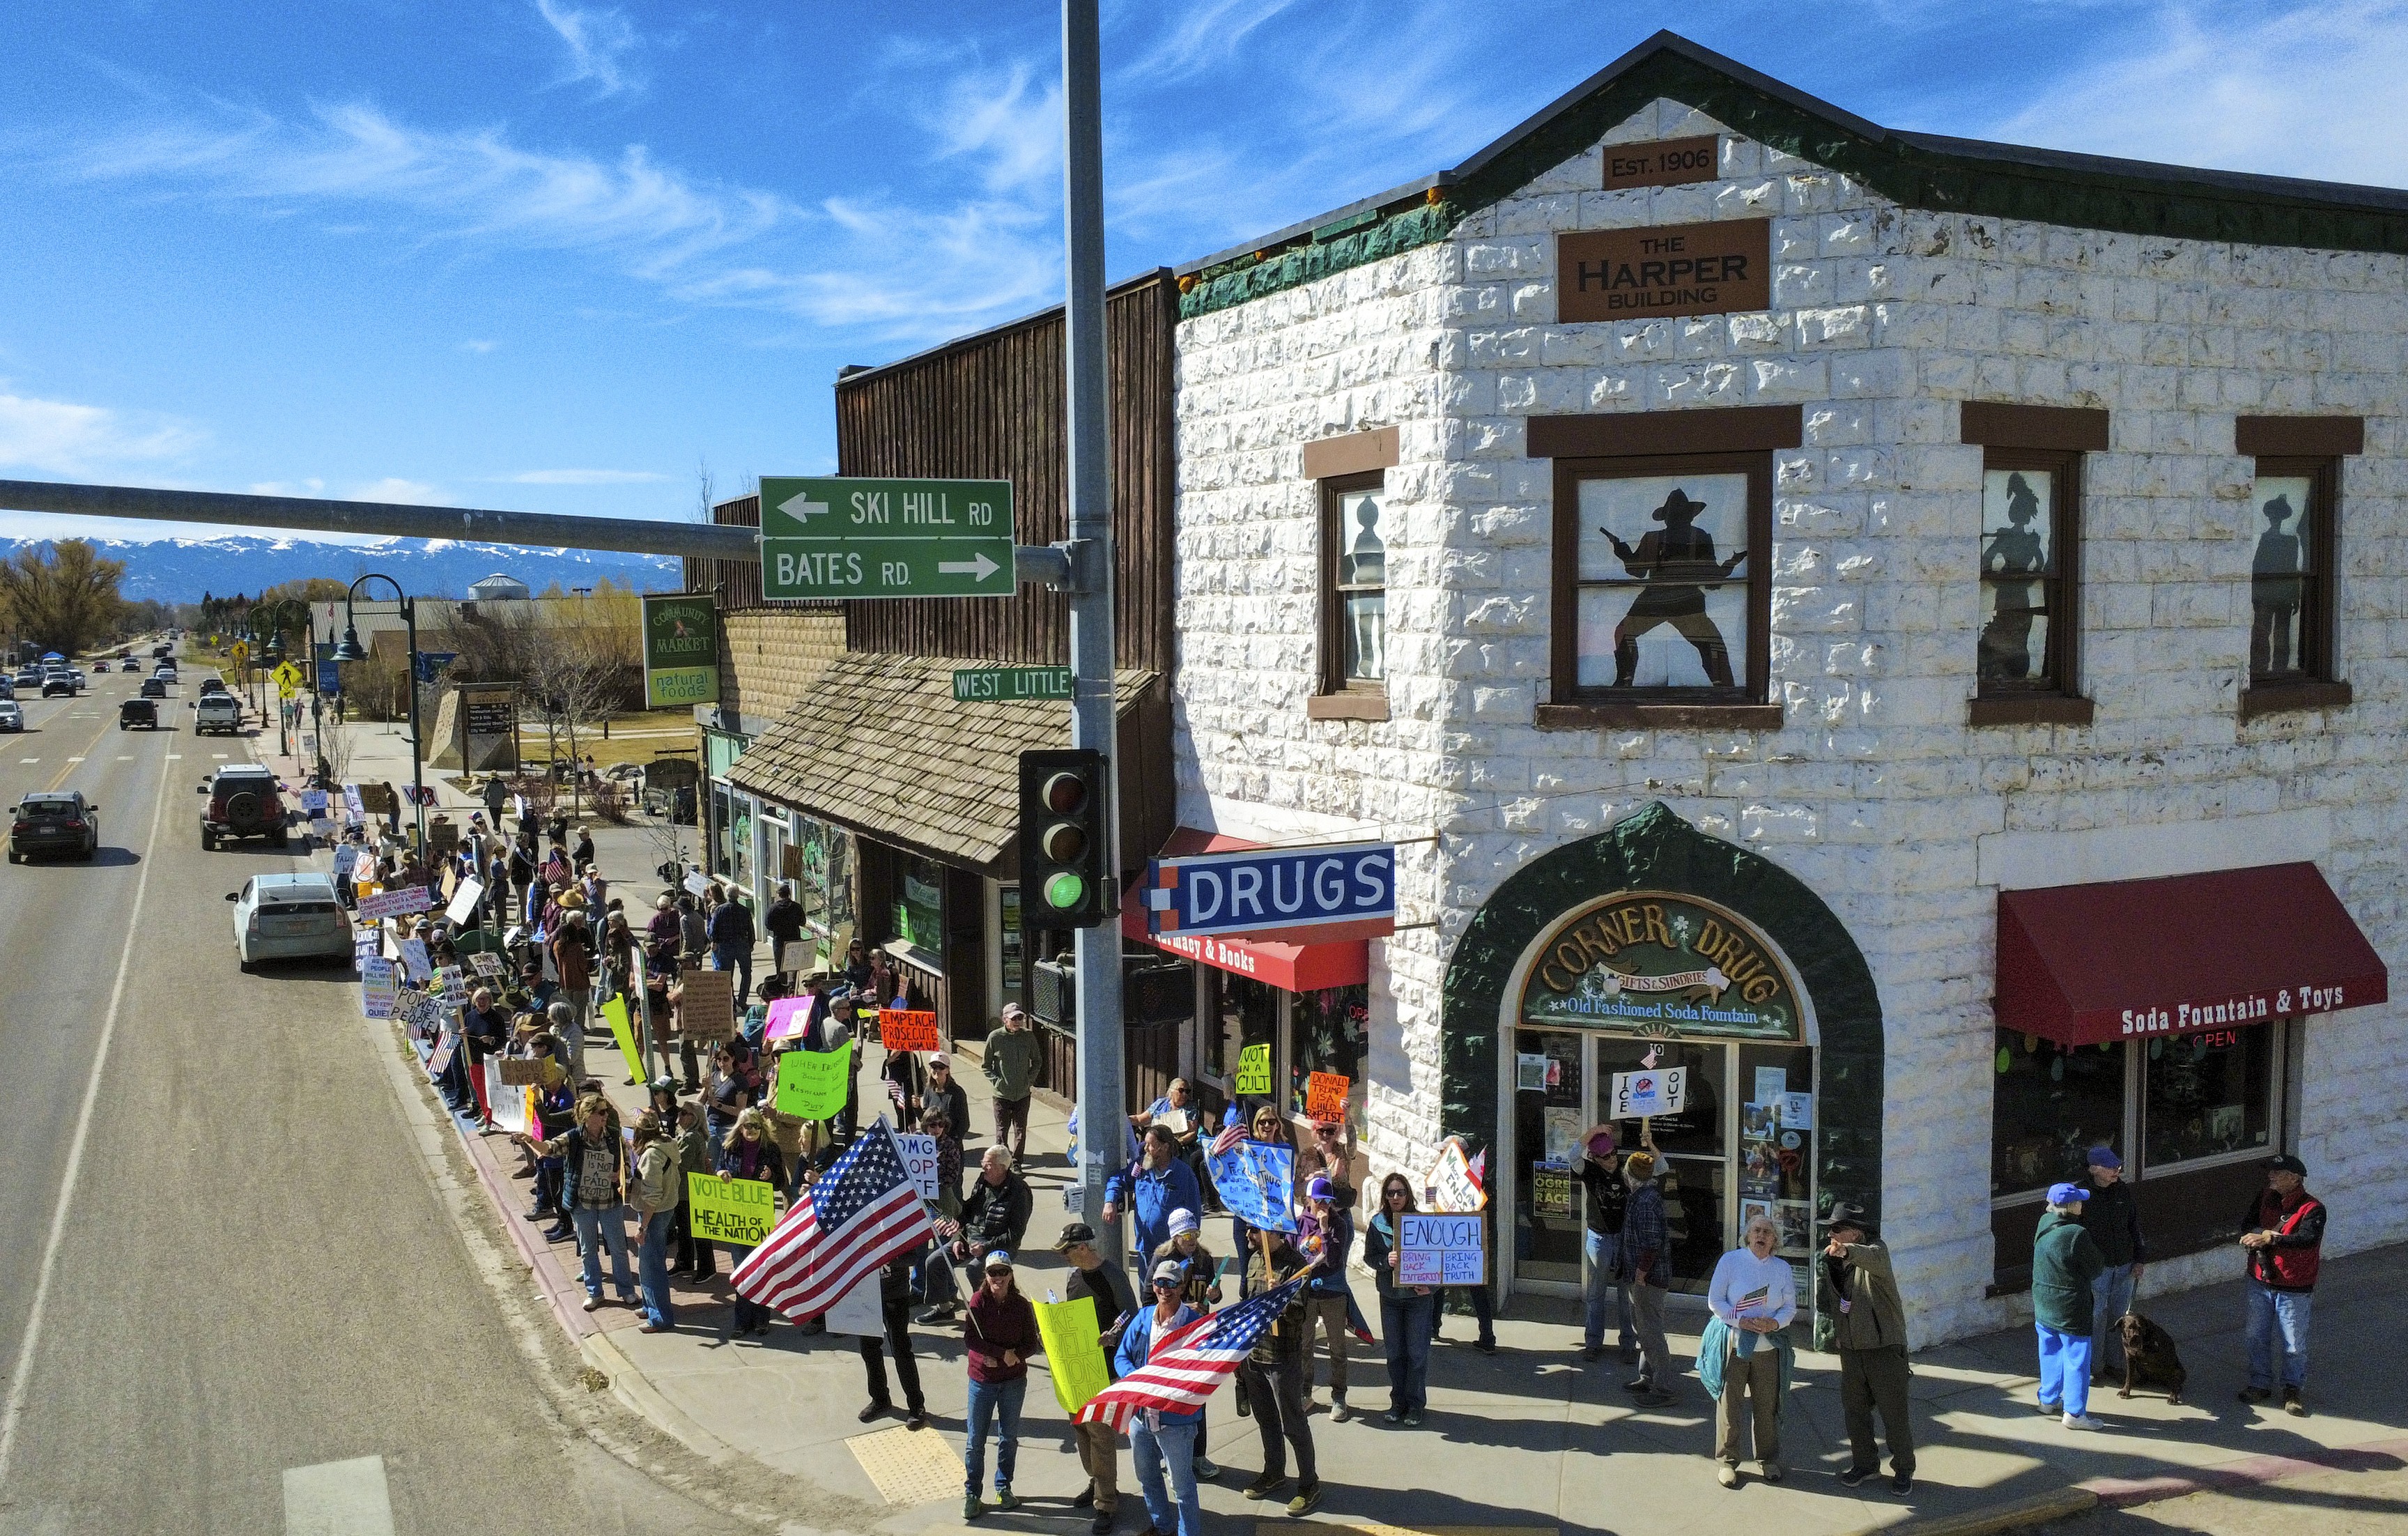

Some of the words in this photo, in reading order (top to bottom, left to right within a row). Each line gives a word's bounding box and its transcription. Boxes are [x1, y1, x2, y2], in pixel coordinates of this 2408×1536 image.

[1659, 150, 1710, 172] 1906
[1640, 237, 1685, 254] THE
[1578, 255, 1749, 293] HARPER
[1607, 288, 1718, 310] BUILDING
[850, 492, 890, 525] SKI
[903, 493, 956, 525] HILL
[968, 502, 992, 526] RD
[776, 553, 864, 586] BATES
[653, 606, 711, 626] COMMUNITY
[656, 636, 710, 654] MARKET
[656, 671, 709, 687] natural
[955, 673, 1003, 698] WEST
[1014, 671, 1070, 695] LITTLE
[661, 685, 707, 698] foods
[1189, 854, 1389, 924] DRUGS
[1205, 939, 1215, 961] &
[1218, 943, 1255, 974] Books
[1542, 905, 1676, 994] CORNER
[1692, 919, 1780, 1005] DRUG
[1620, 974, 1651, 990] GIFTS
[398, 988, 442, 1015] POWER
[2122, 1009, 2170, 1034] Soda
[2178, 993, 2269, 1028] Fountain
[2276, 990, 2292, 1013] &
[2299, 985, 2345, 1009] Toys
[1567, 997, 1591, 1014] Old
[1594, 999, 1662, 1018] Fashioned
[1664, 1004, 1699, 1020] Soda
[1700, 1005, 1758, 1024] Fountain
[391, 1006, 437, 1032] PEOPLE
[881, 1011, 936, 1027] IMPEACH
[882, 1025, 938, 1040] PROSECUTE
[883, 1040, 907, 1050] LOCK
[908, 1041, 925, 1050] HIM
[926, 1041, 938, 1050] UP
[1240, 1047, 1268, 1063] NOT
[1240, 1065, 1249, 1073] IN
[1237, 1075, 1269, 1091] CULT
[1313, 1073, 1348, 1087] DONALD
[1311, 1083, 1342, 1095] TRUMP
[1619, 1075, 1630, 1113] ICE
[1667, 1071, 1680, 1107] OUT
[1311, 1101, 1336, 1112] CHILD
[1327, 1094, 1335, 1103] A
[585, 1151, 605, 1162] THIS
[597, 1162, 613, 1172] NOT
[583, 1176, 609, 1188] PAID
[1258, 1171, 1281, 1188] THUG
[1535, 1178, 1569, 1189] OGRE
[693, 1177, 730, 1201] VOTE
[732, 1183, 770, 1206] BLUE
[1535, 1192, 1569, 1204] RACE
[695, 1208, 746, 1227] HEALTH
[749, 1217, 764, 1226] OF
[703, 1225, 720, 1236] THE
[725, 1227, 771, 1243] NATION
[1403, 1220, 1481, 1247] ENOUGH
[1402, 1252, 1430, 1262] BRING
[1445, 1252, 1477, 1262] BRING
[1403, 1262, 1425, 1271] BACK
[1445, 1262, 1470, 1272] BACK
[1444, 1271, 1475, 1282] TRUTH
